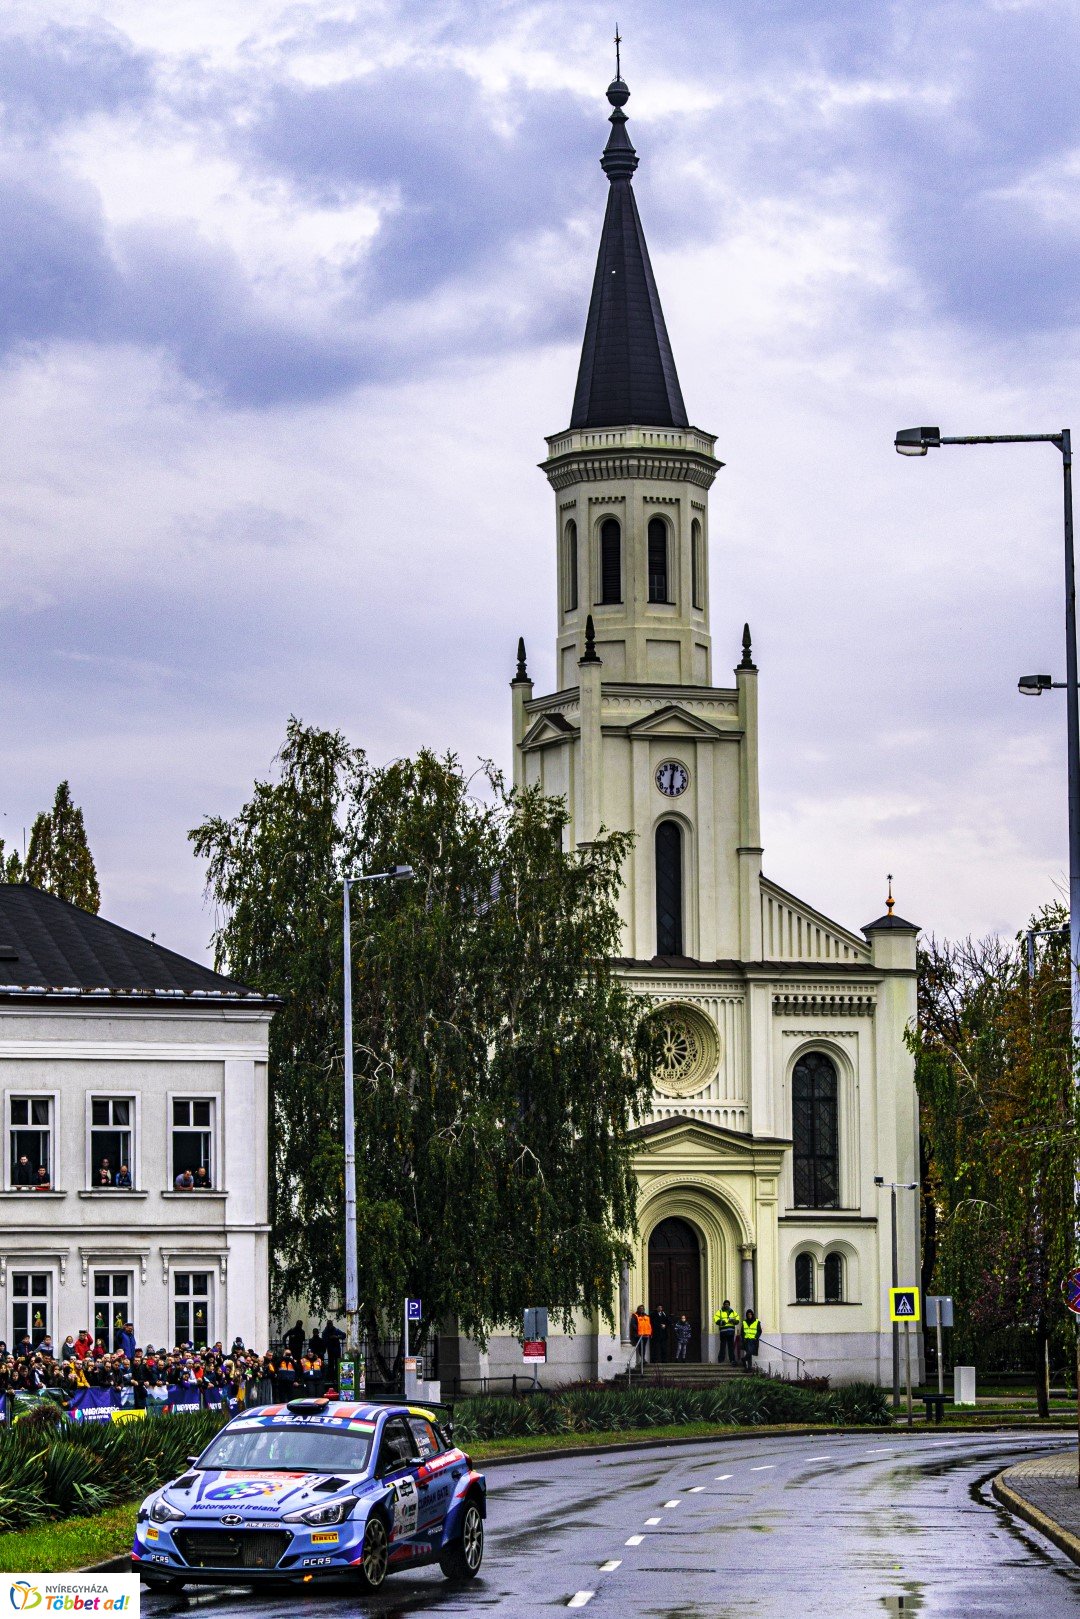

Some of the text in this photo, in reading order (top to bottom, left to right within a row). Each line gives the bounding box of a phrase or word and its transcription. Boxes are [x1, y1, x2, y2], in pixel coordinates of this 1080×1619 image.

[409, 1302, 419, 1315] P
[272, 1415, 343, 1425] SEAJETS
[191, 1503, 281, 1512] Motorsport Ireland
[312, 1533, 338, 1542] PIRELLI
[151, 1554, 169, 1563] PCRS
[303, 1557, 331, 1566] PCRS
